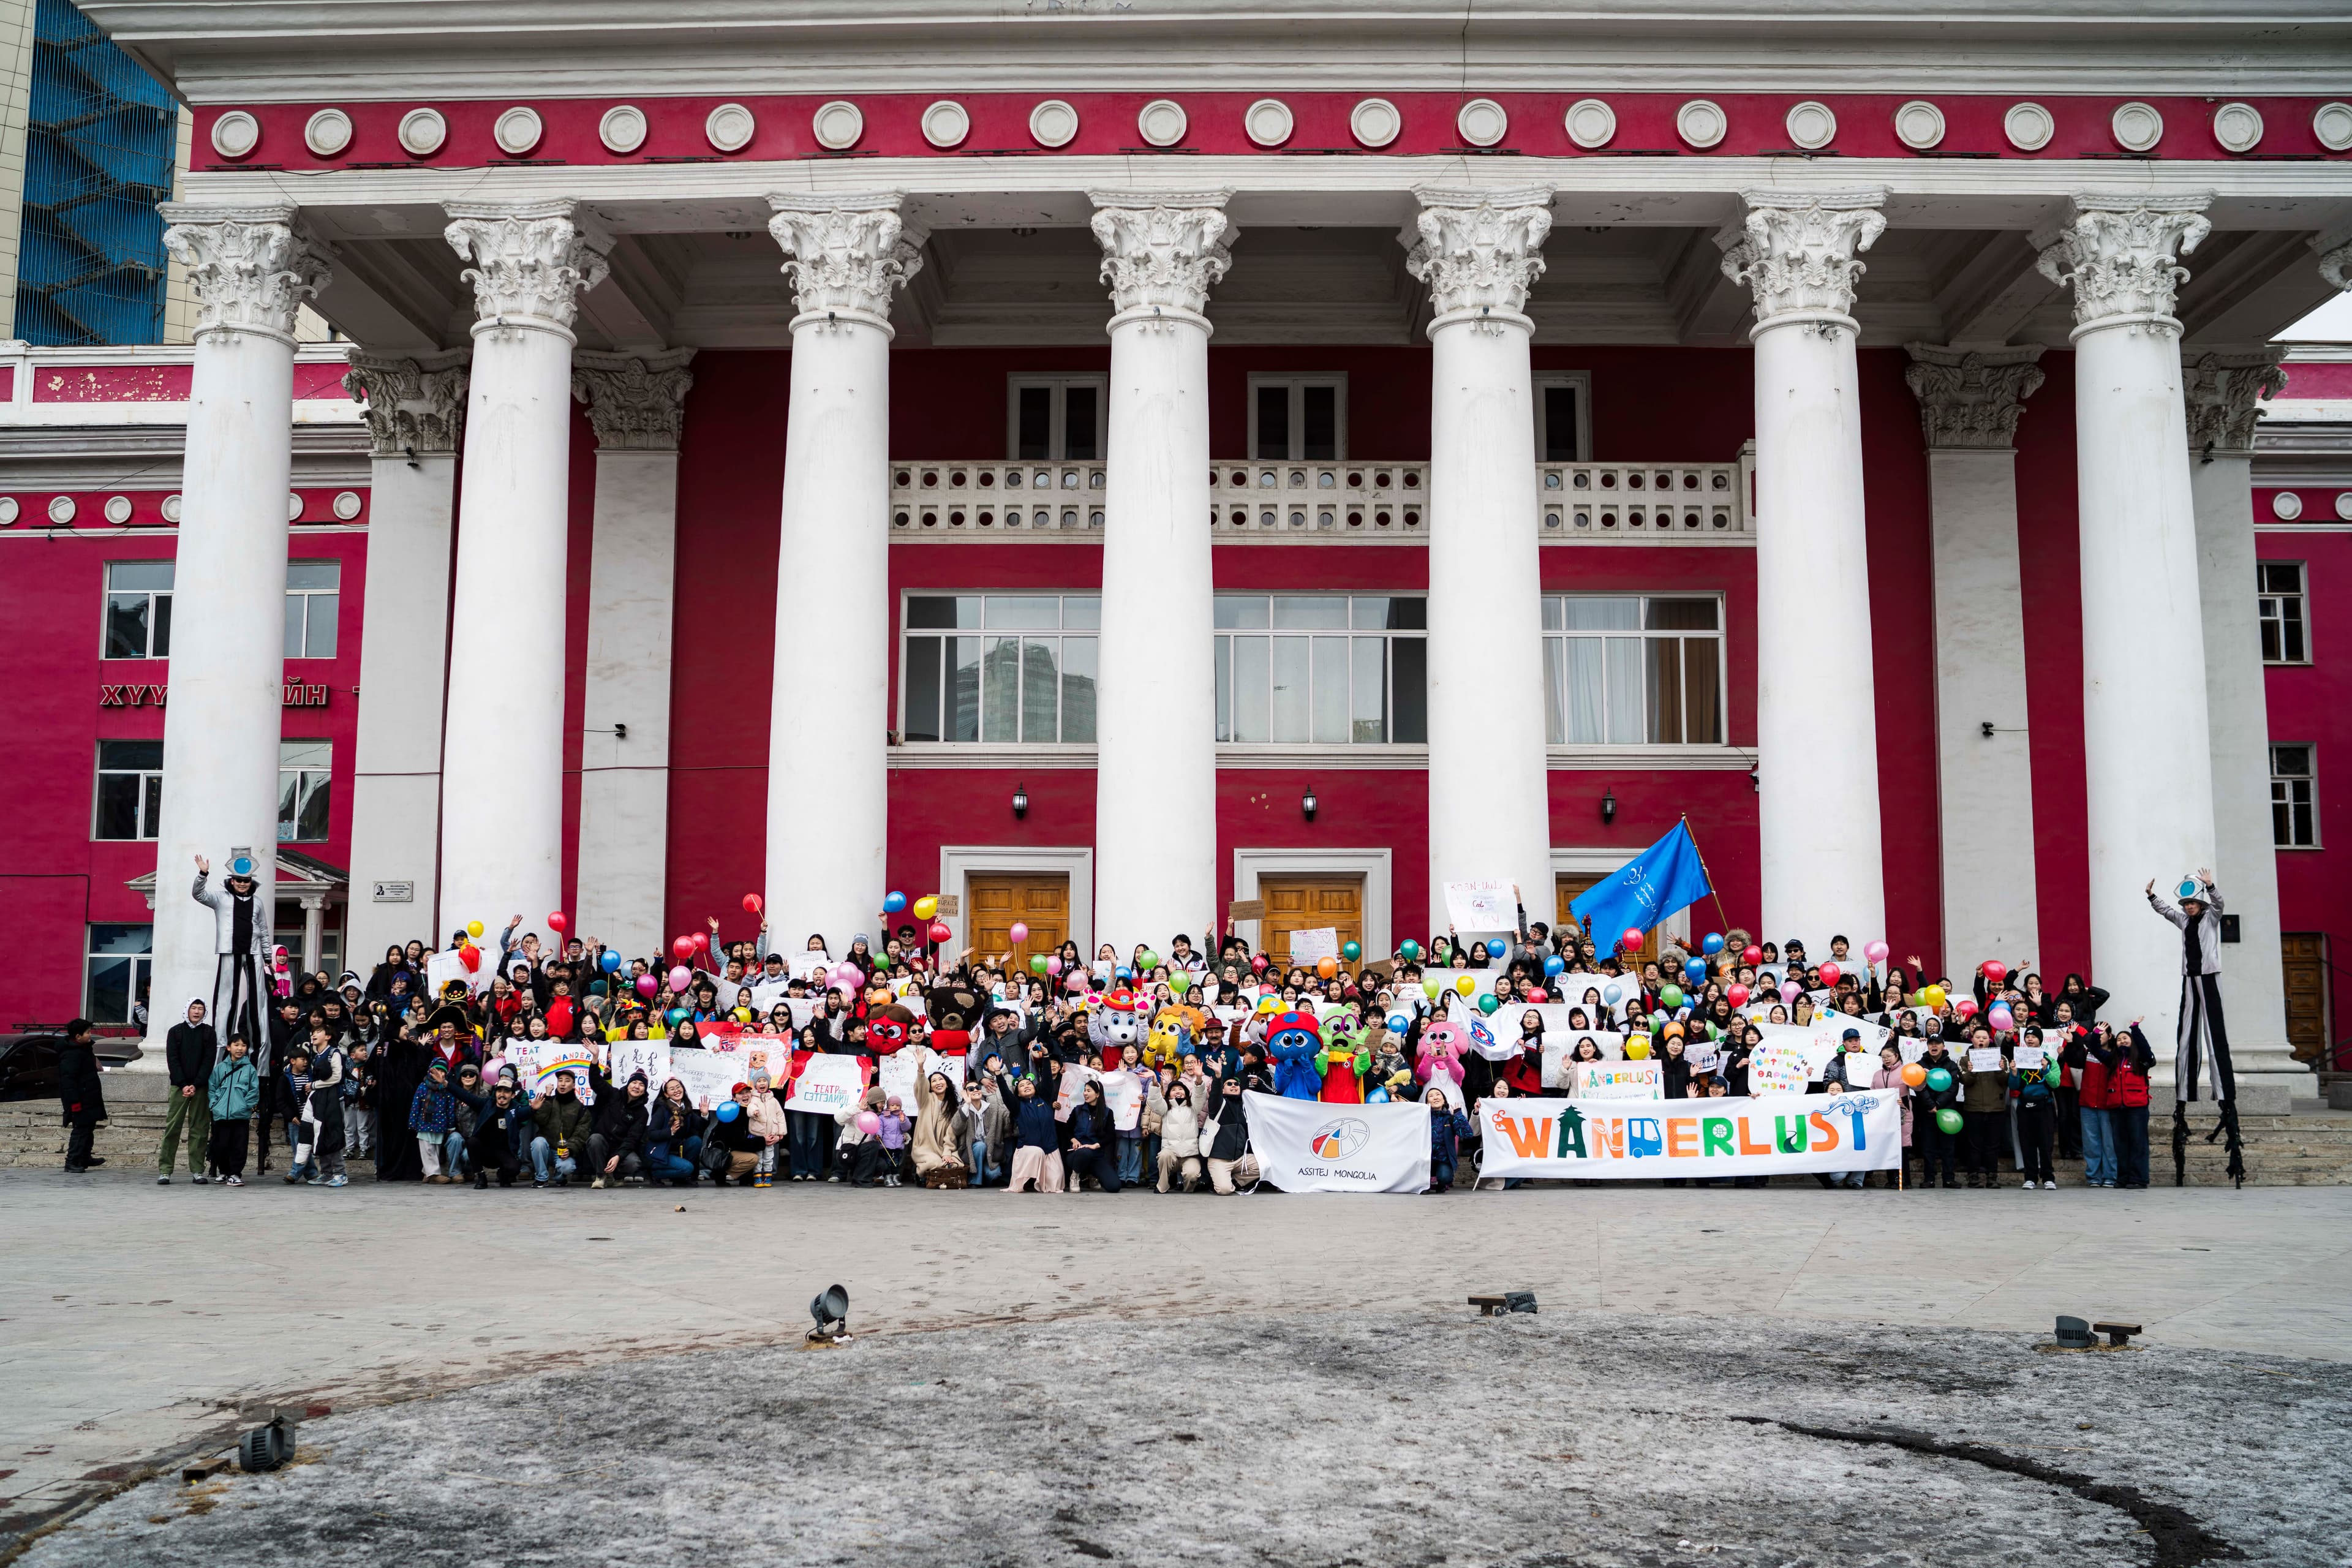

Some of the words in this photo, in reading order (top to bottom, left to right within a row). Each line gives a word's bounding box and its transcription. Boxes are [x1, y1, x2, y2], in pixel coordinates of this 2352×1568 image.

[813, 1084, 840, 1094] ТЕАТР
[1493, 1095, 1879, 1159] WANDERLUST
[1298, 1161, 1329, 1177] ASSITEJ
[1334, 1169, 1377, 1181] MONGOLIA
